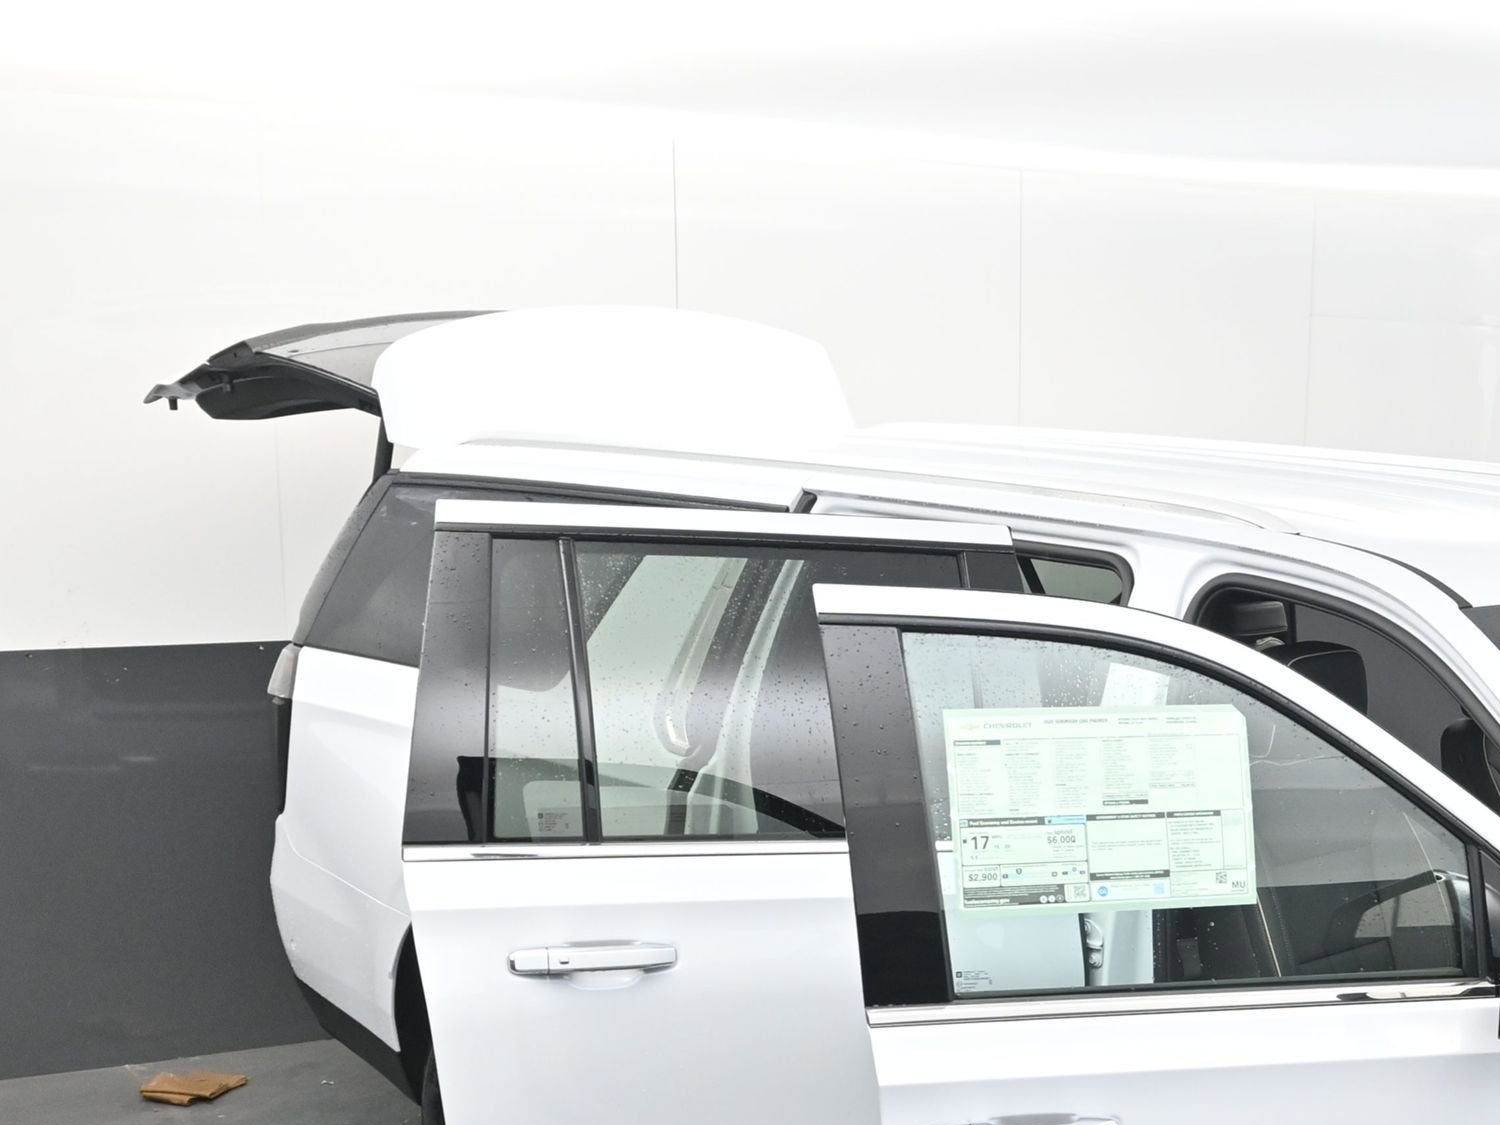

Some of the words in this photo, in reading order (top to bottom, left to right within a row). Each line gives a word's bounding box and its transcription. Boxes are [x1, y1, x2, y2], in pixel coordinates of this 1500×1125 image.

[983, 721, 1032, 729] CHEVROLET
[971, 836, 989, 850] 17
[1232, 880, 1246, 889] MU
